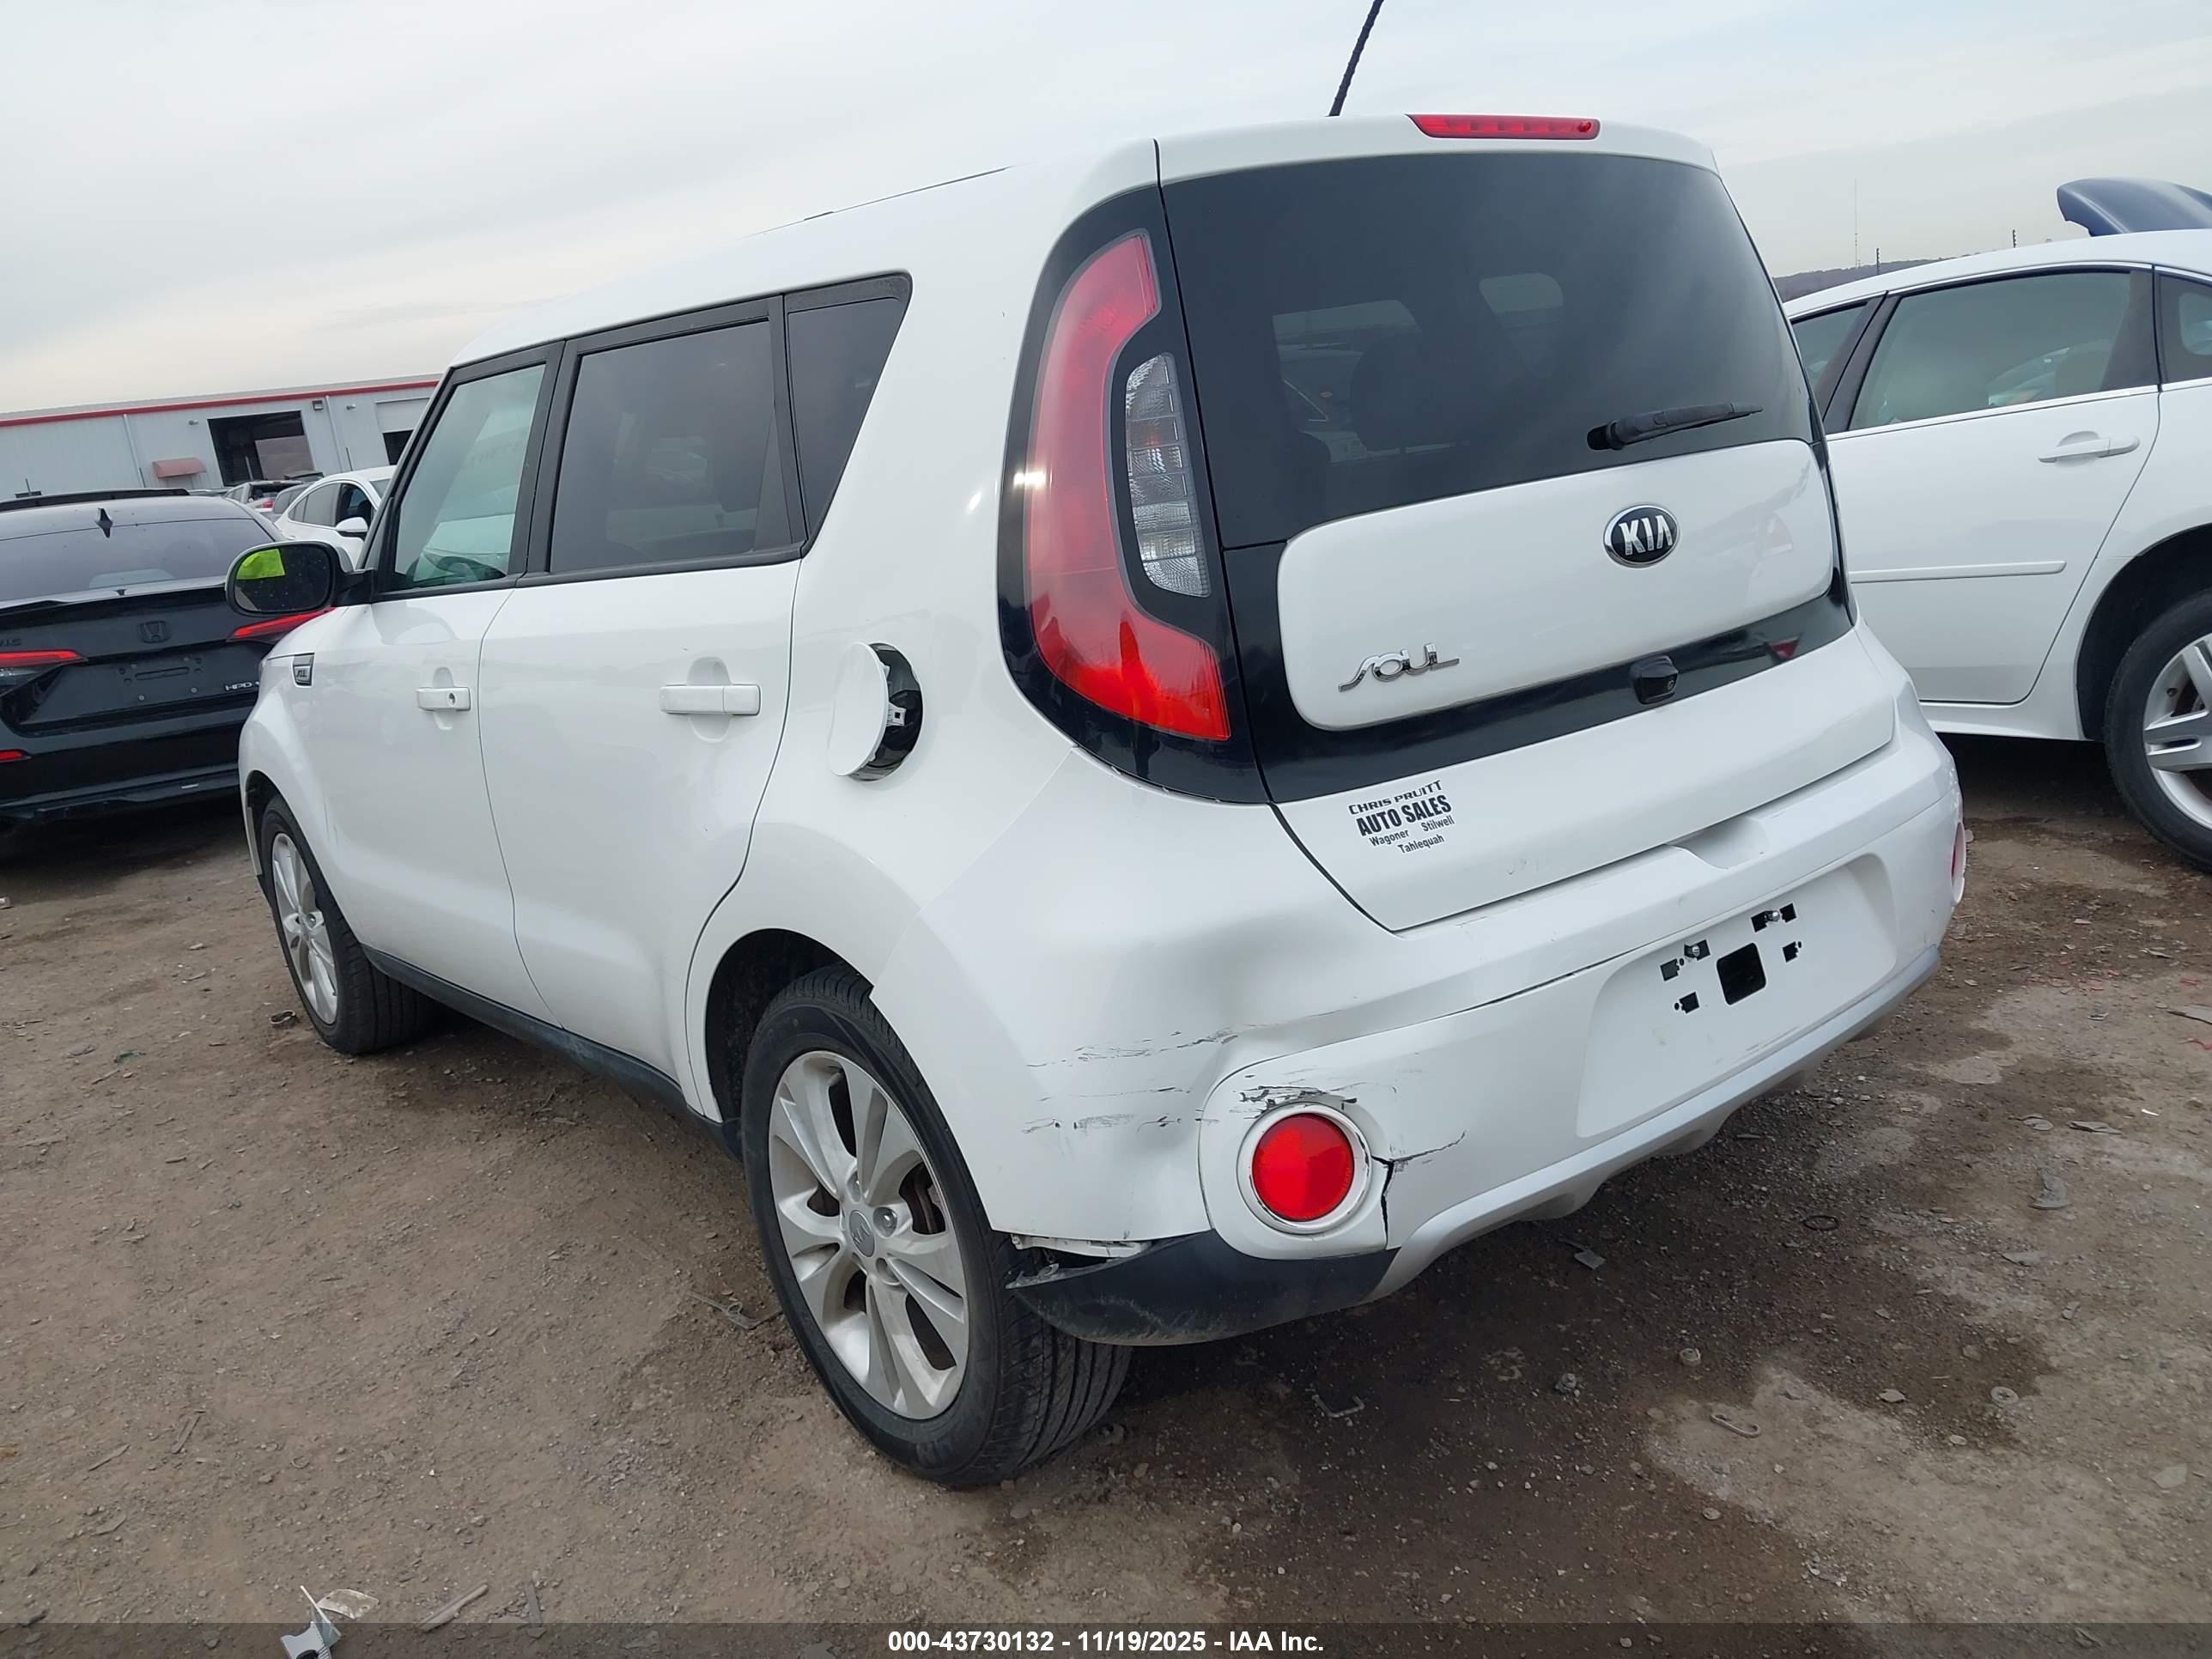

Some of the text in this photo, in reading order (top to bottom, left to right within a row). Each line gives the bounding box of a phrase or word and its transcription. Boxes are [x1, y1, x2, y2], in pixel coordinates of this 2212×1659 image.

[1618, 514, 1673, 556] KIA
[1338, 642, 1460, 692] SOUL
[1348, 780, 1442, 815] CHRIS PRUITT
[1356, 794, 1452, 836] AUTO SALES
[1369, 815, 1455, 847] Wagoner Stilwell
[1397, 834, 1445, 854] Tahlequah
